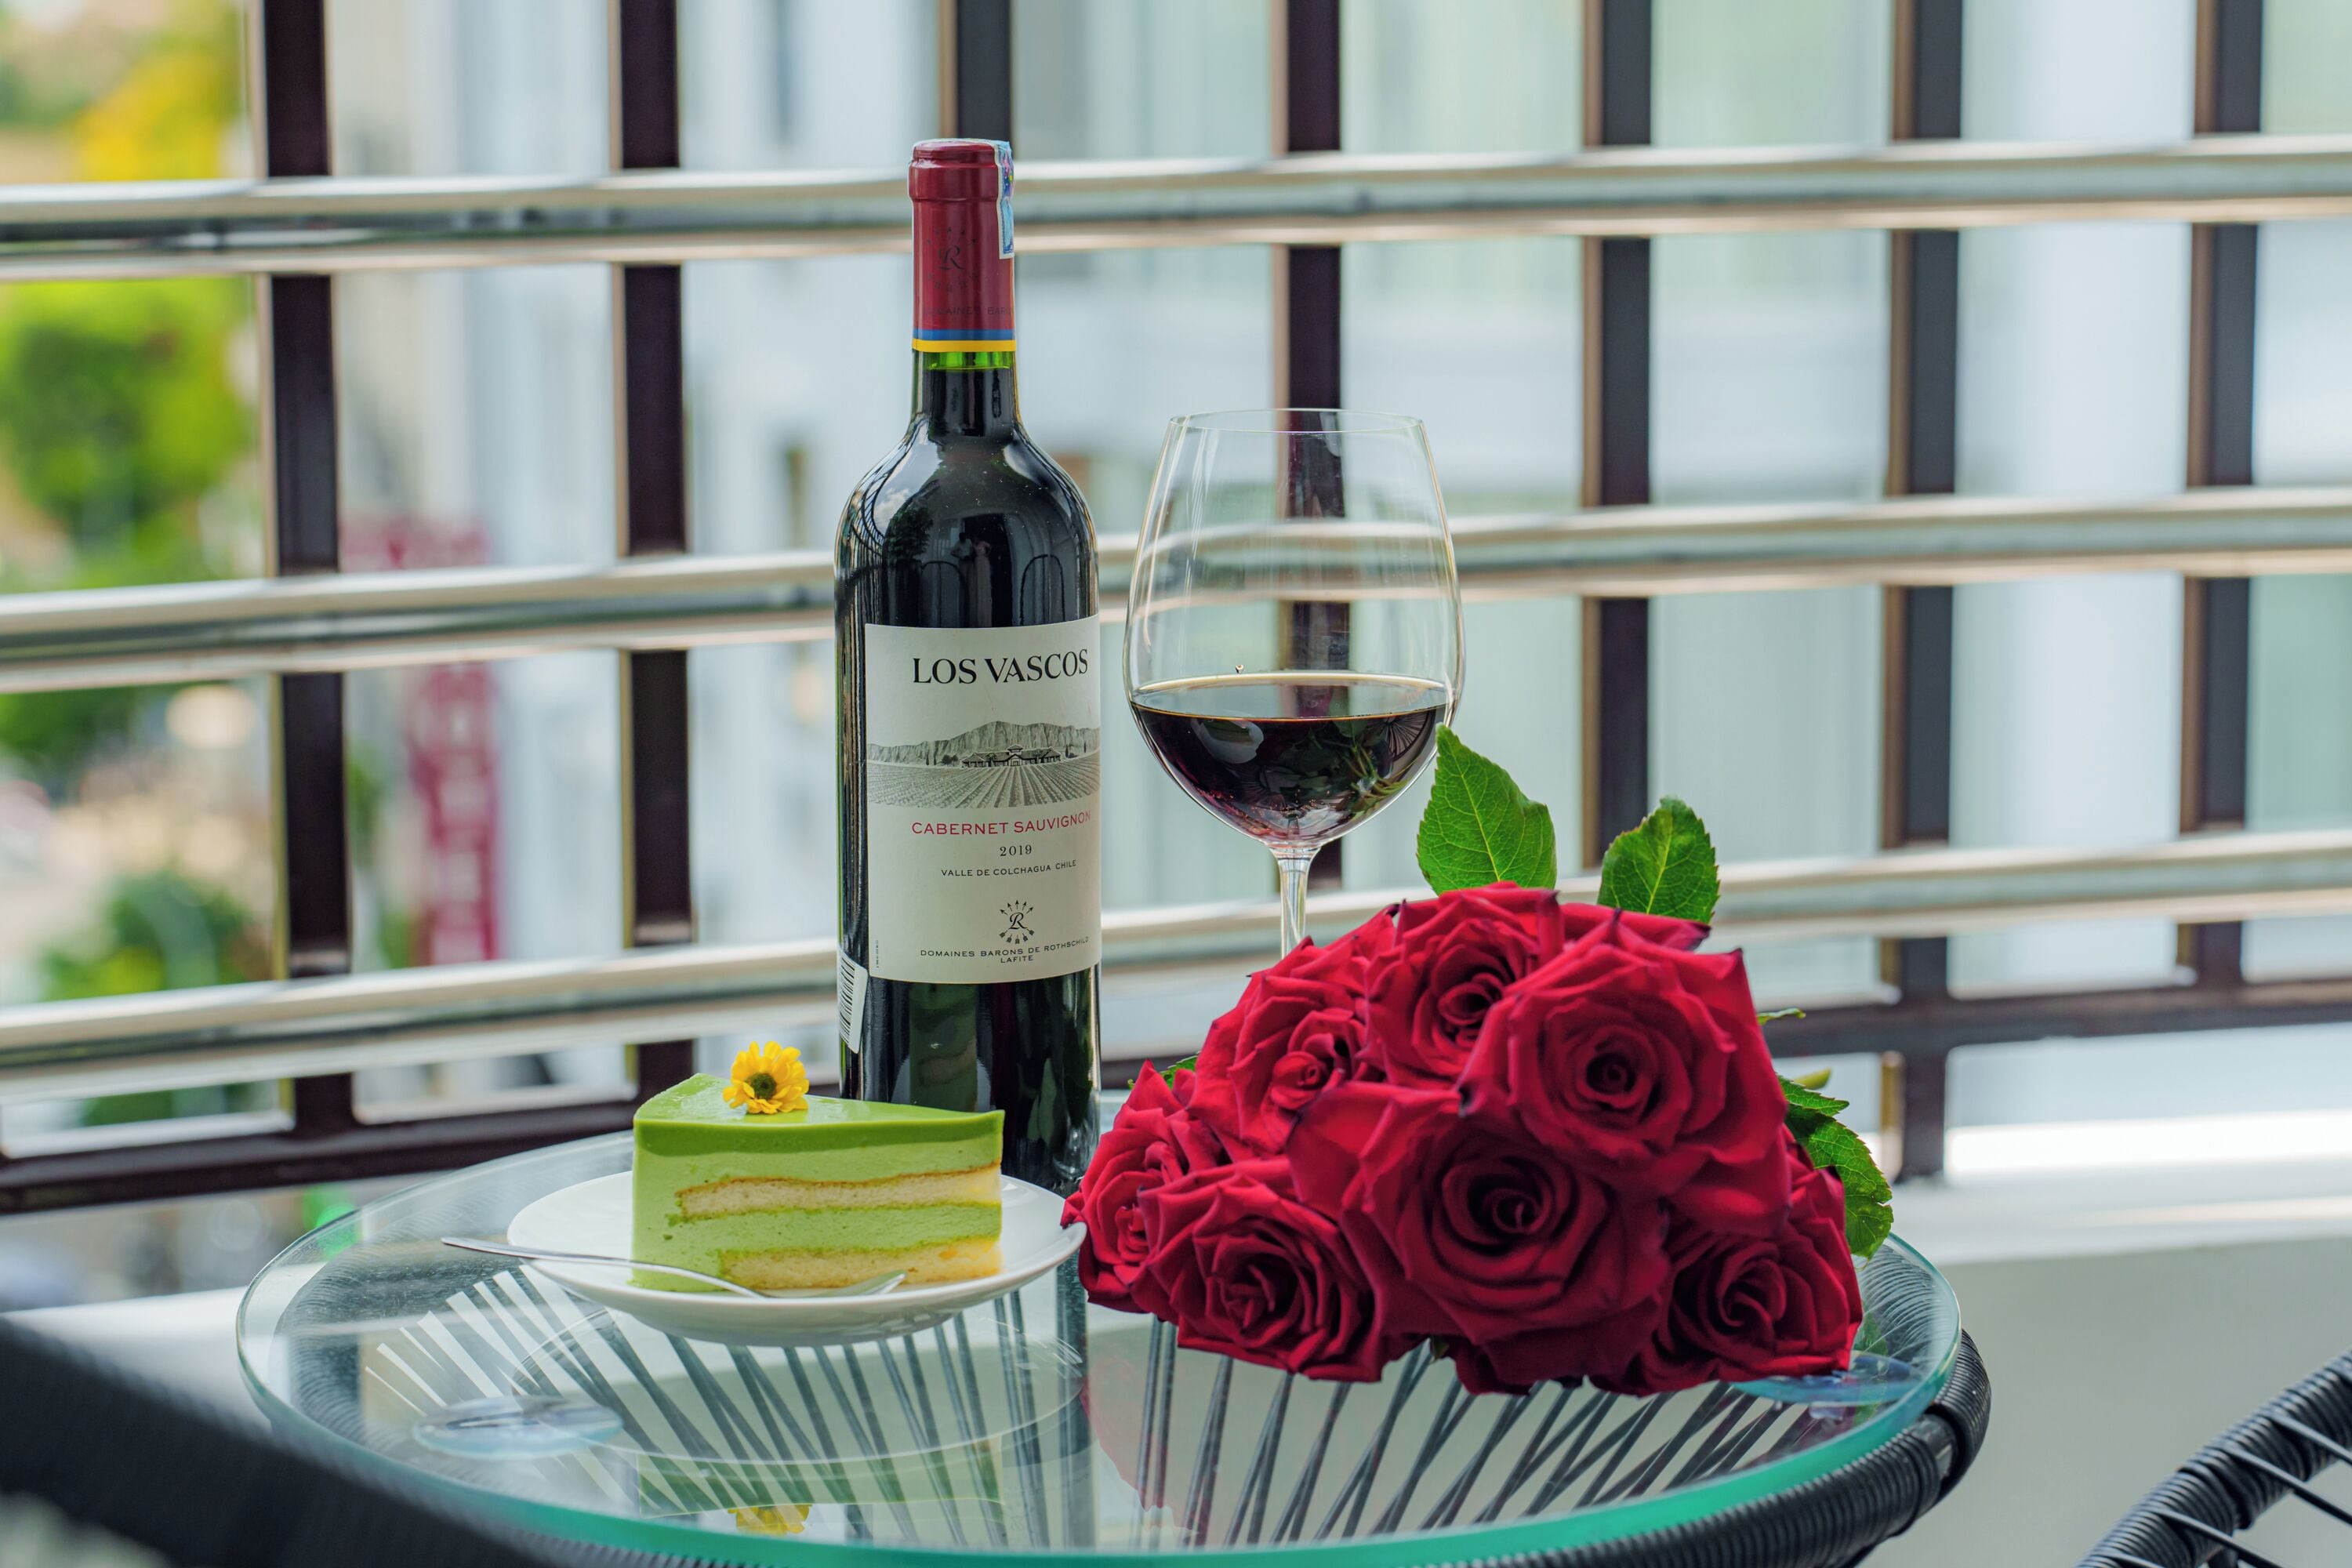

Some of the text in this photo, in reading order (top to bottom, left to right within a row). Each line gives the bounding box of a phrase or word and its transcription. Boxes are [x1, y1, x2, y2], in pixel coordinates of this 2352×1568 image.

[913, 648, 1088, 684] LOS VASCOS
[912, 810, 1091, 835] CABERNET SAUVIGNON
[1000, 844, 1033, 857] 2019
[993, 865, 1051, 876] COLCHAGUA
[1055, 859, 1076, 870] CHILE
[1009, 912, 1027, 930] R
[1044, 936, 1089, 952] ROTHSCHILD
[1000, 955, 1034, 964] LAFITE
